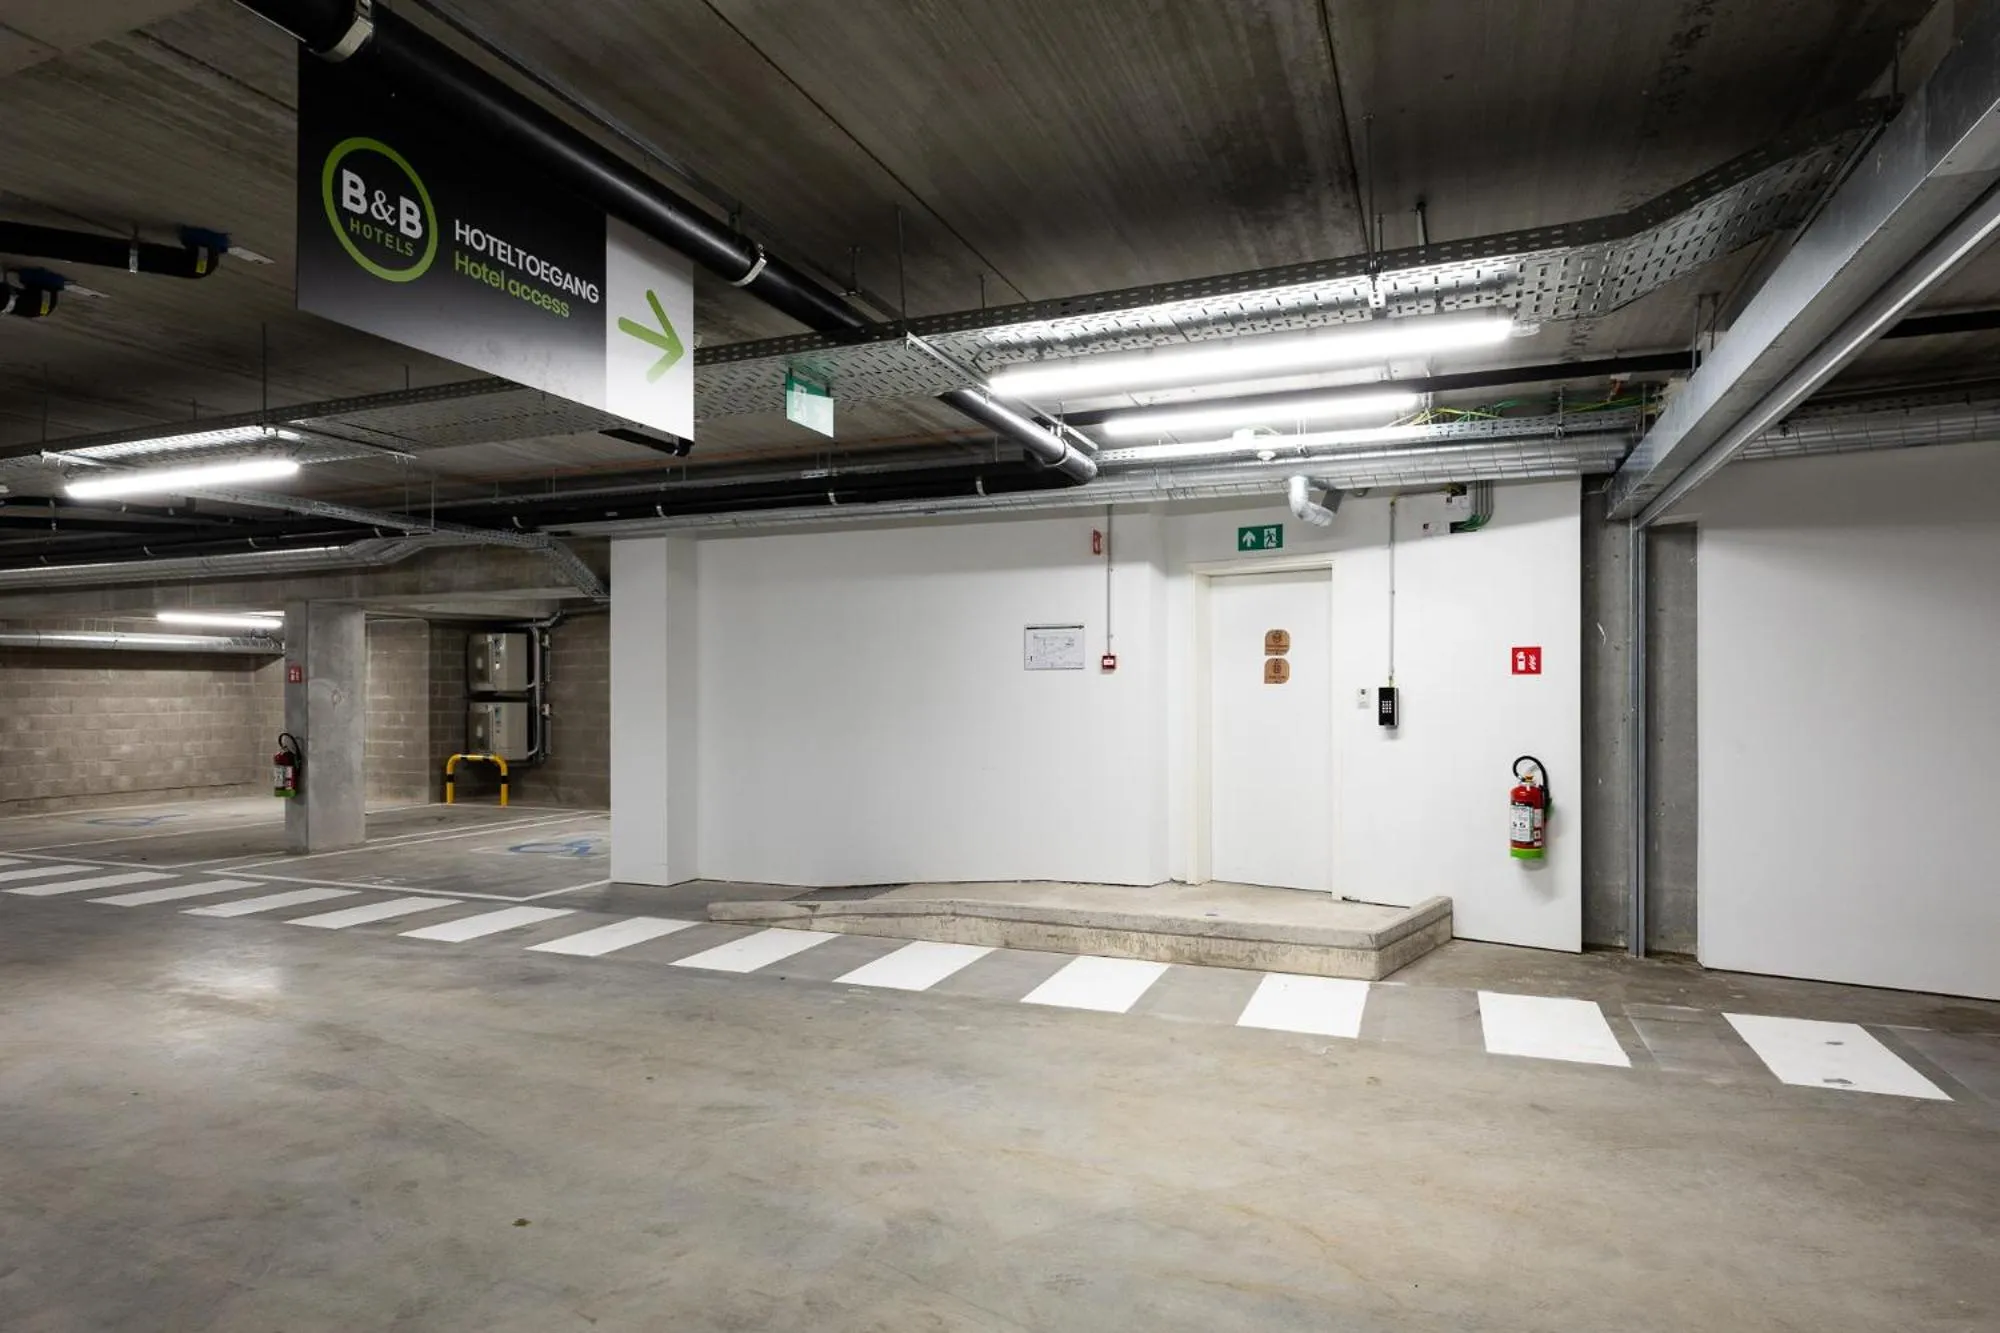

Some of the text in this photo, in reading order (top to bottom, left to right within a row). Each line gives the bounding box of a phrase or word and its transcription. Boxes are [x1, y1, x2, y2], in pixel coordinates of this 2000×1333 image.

[342, 168, 423, 239] B&B
[350, 218, 414, 257] HOTELS
[455, 219, 600, 304] HOTELTOEGANG
[455, 251, 570, 318] Hotel access
